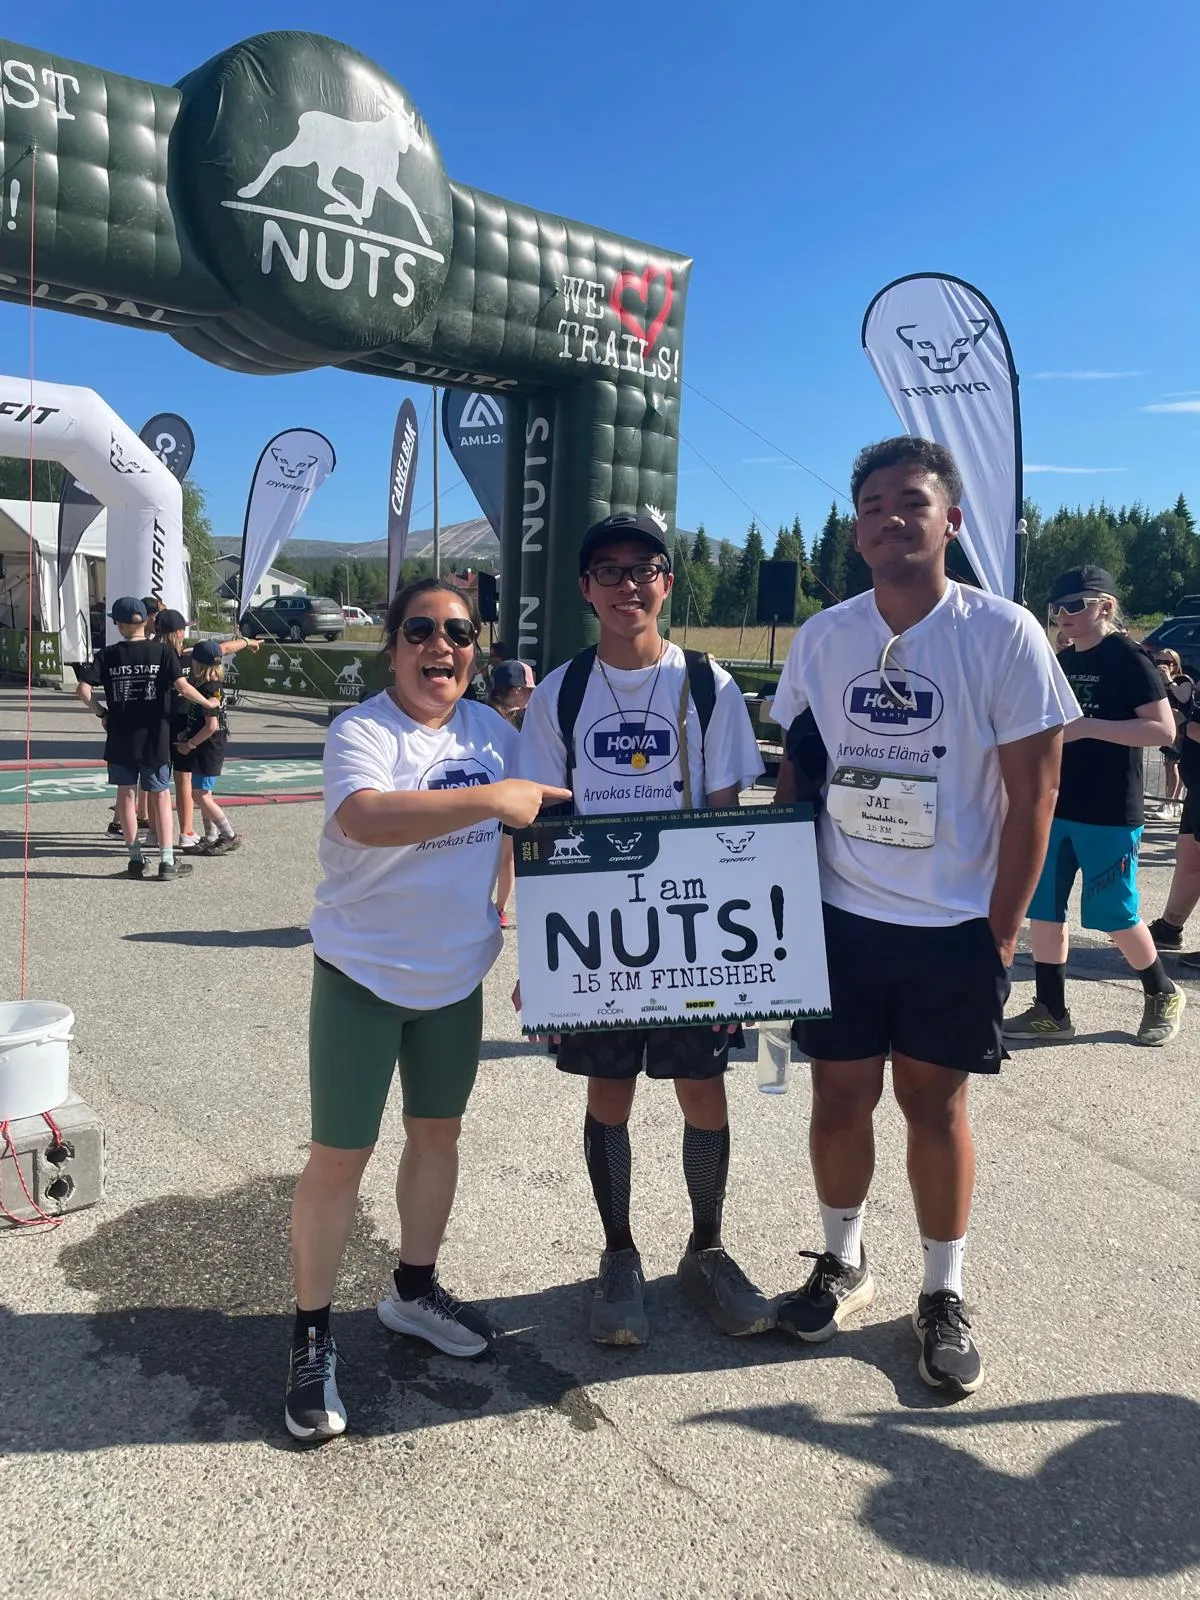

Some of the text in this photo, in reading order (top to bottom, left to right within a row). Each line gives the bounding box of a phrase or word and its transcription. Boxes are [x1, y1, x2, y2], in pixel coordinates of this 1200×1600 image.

[2, 60, 80, 120] ST
[262, 219, 417, 308] NUTS
[561, 274, 605, 319] WE
[558, 319, 680, 383] TRAILS!
[0, 402, 61, 424] FIT
[392, 417, 417, 516] CAMELBAK
[265, 480, 311, 493] DYNAFIT
[521, 417, 549, 552] NUTS
[151, 518, 166, 602] NAFIT
[109, 664, 160, 676] NUTS STAFF
[223, 674, 237, 685] UTS
[339, 686, 360, 697] NUTS
[888, 745, 930, 763] Elämä
[583, 785, 672, 802] Arvokas Elämä
[866, 795, 891, 810] JAI
[866, 824, 892, 834] 15 KM
[416, 836, 464, 852] Arvokas
[522, 841, 532, 861] 2025
[719, 856, 756, 864] DYNAFIT
[627, 873, 707, 903] I am
[545, 884, 787, 972] NUTS!
[572, 963, 776, 994] 15 KM FINISHER
